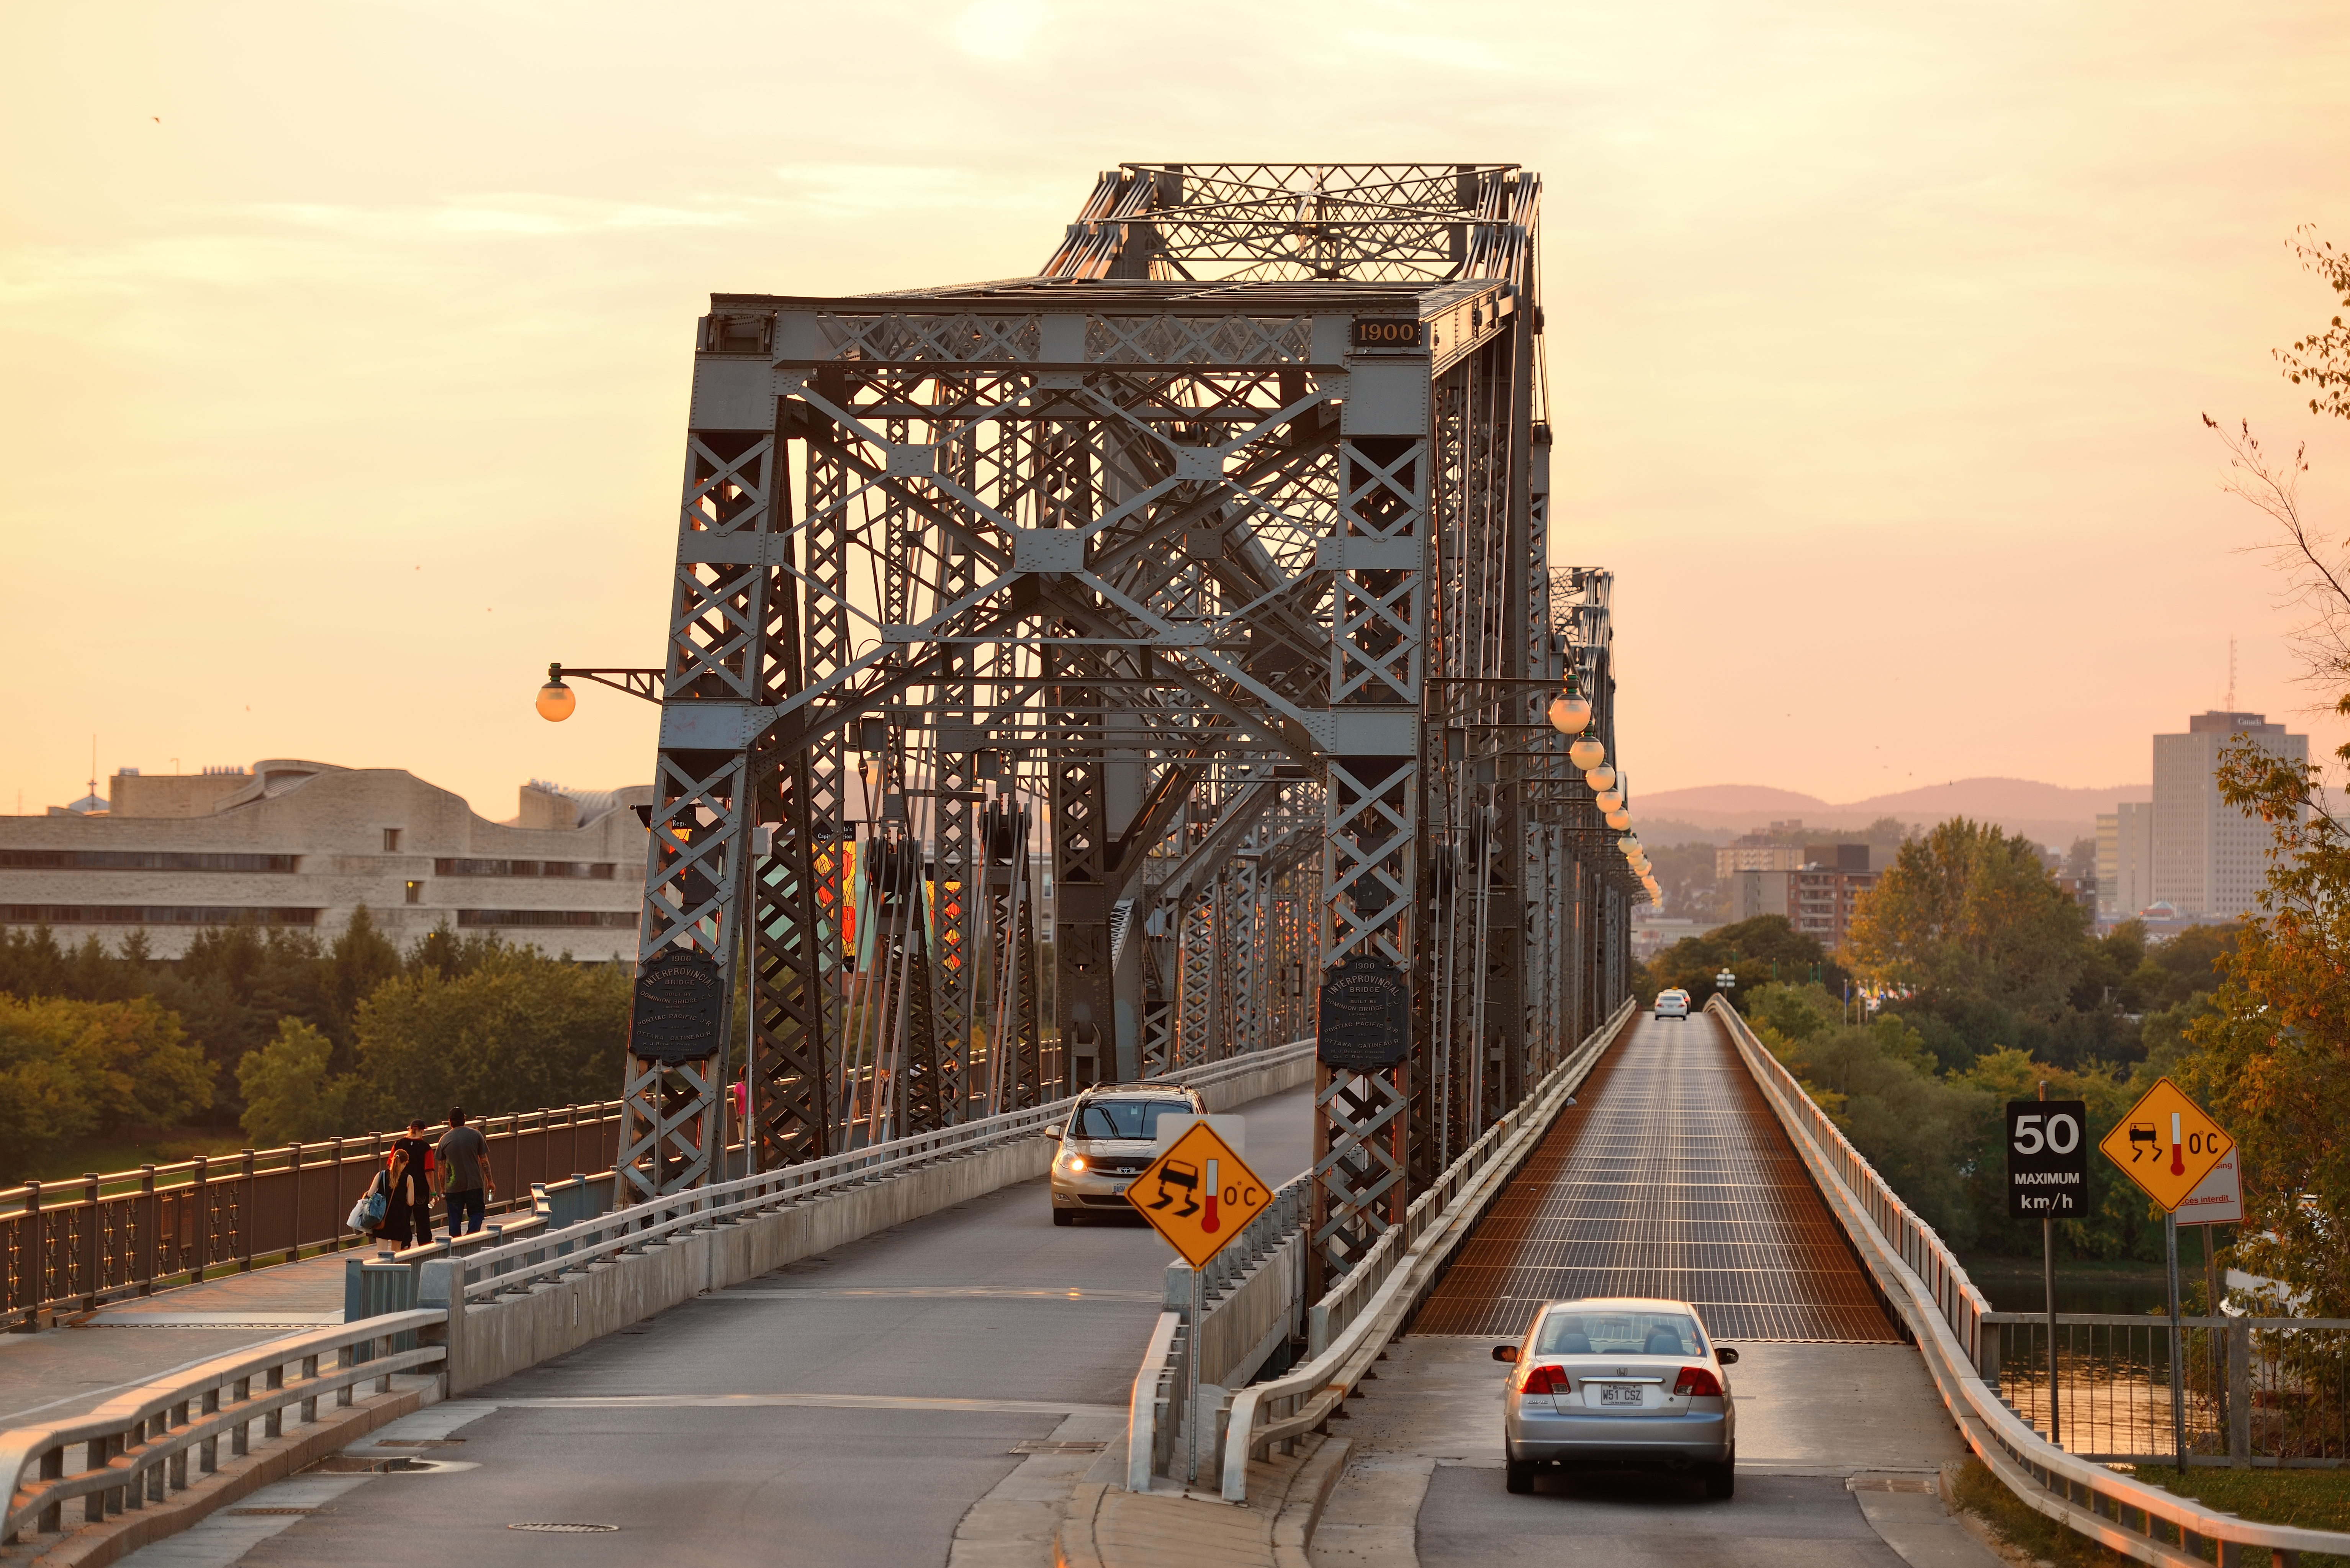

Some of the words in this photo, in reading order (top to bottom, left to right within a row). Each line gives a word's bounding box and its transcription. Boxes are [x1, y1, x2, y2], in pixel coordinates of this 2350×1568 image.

[1360, 324, 1414, 341] 1900
[2238, 717, 2262, 726] Canada
[643, 968, 715, 990] INTERPROVINCIAL
[1327, 975, 1400, 997] INTERPROVINCIAL
[640, 990, 671, 1003] DOMINION
[1326, 998, 1356, 1011] DOMINION
[637, 1015, 666, 1026] PONTIAC
[1324, 1022, 1353, 1034] PONTIAC
[637, 1031, 664, 1040] OTTAWA
[670, 1033, 705, 1041] GATINEAU
[1324, 1038, 1351, 1048] OTTAWA
[1358, 1040, 1392, 1048] GATINEAU
[2014, 1113, 2079, 1154] 50
[2015, 1172, 2080, 1184] MAXIMUM
[2021, 1192, 2073, 1210] km/h
[2201, 1195, 2229, 1203] interdit
[1603, 1390, 1618, 1400] W51
[1625, 1390, 1641, 1401] CSZ
